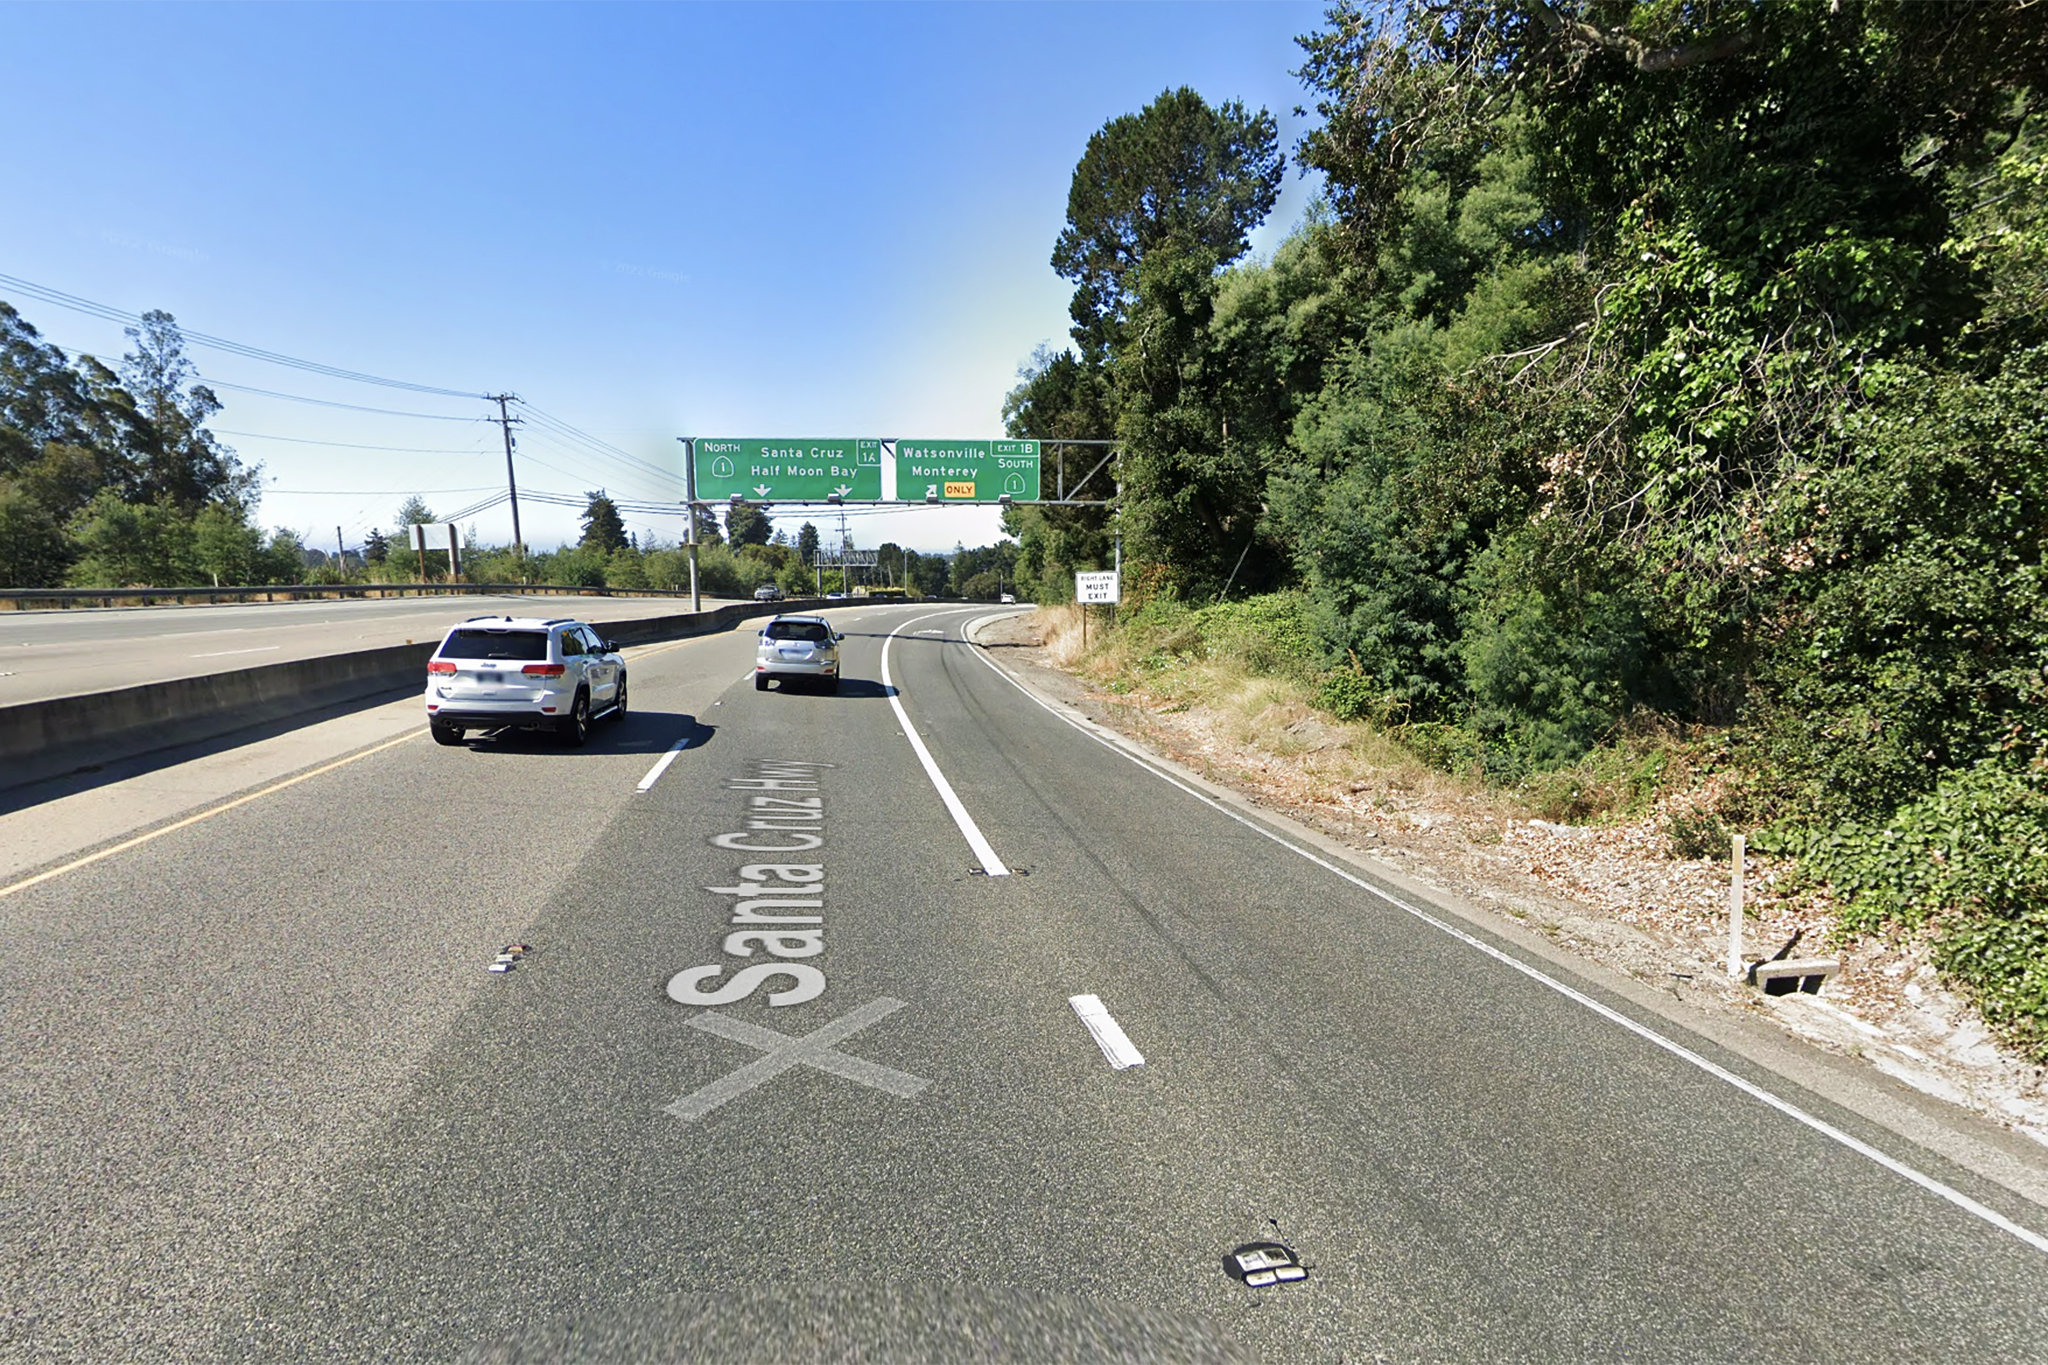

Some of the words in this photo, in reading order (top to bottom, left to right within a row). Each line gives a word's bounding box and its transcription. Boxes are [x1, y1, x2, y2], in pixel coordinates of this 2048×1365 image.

[704, 442, 741, 453] NORTH
[860, 441, 878, 449] EXIT
[996, 444, 1016, 452] EXIT
[1020, 444, 1034, 454] 1B
[761, 447, 803, 459] Santa
[810, 447, 845, 459] Cruz
[862, 452, 876, 463] 1A
[903, 447, 986, 459] Watsonville
[720, 461, 726, 473] 1
[998, 458, 1034, 469] SOUTH
[751, 465, 781, 477] Half
[787, 465, 824, 477] Moon
[831, 465, 858, 479] Bay
[912, 465, 979, 479] Monterey
[946, 485, 974, 494] ONLY
[1012, 479, 1018, 490] 1
[1088, 592, 1107, 600] EXIT
